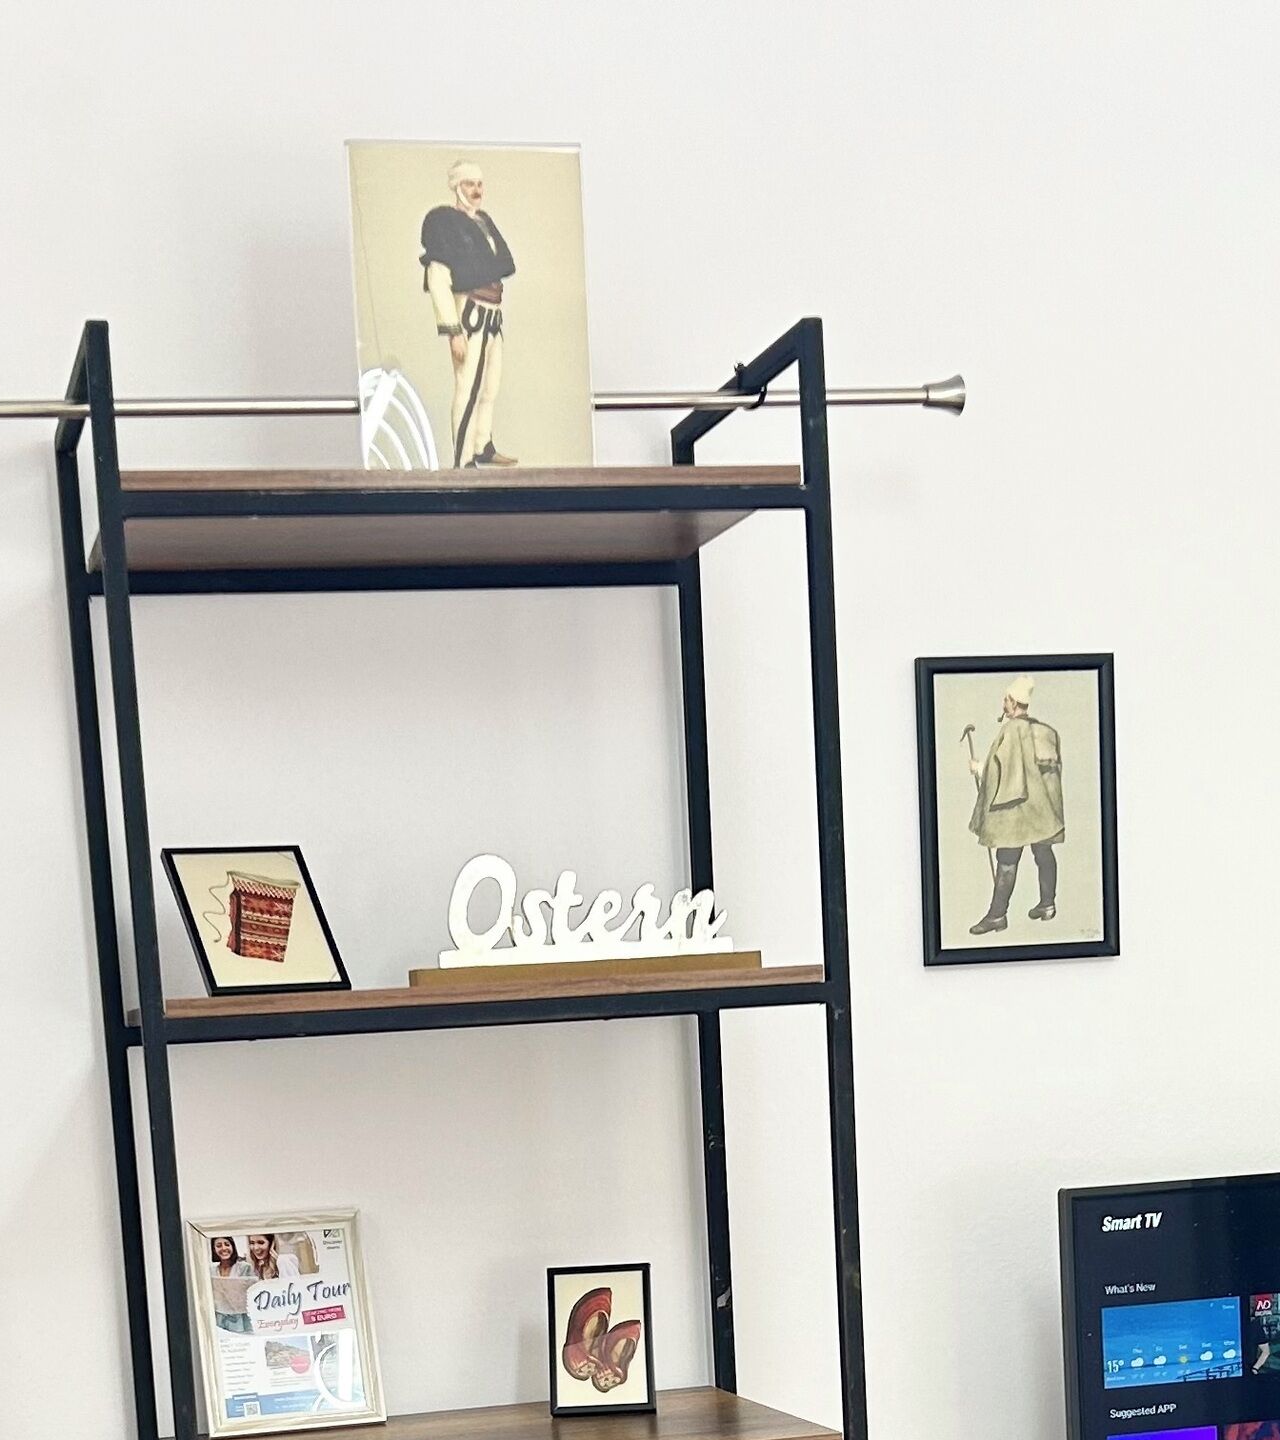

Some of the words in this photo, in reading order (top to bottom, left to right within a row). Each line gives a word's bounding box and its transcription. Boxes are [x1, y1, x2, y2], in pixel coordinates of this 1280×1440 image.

[447, 852, 729, 951] Ostern
[1102, 1214, 1142, 1232] Smart
[1144, 1212, 1163, 1228] TV
[253, 1282, 302, 1316] Daily
[306, 1280, 352, 1301] Tour
[1105, 1283, 1135, 1295] What's
[1136, 1282, 1156, 1292] New
[1109, 1406, 1156, 1419] Suggested
[1157, 1403, 1177, 1414] APP
